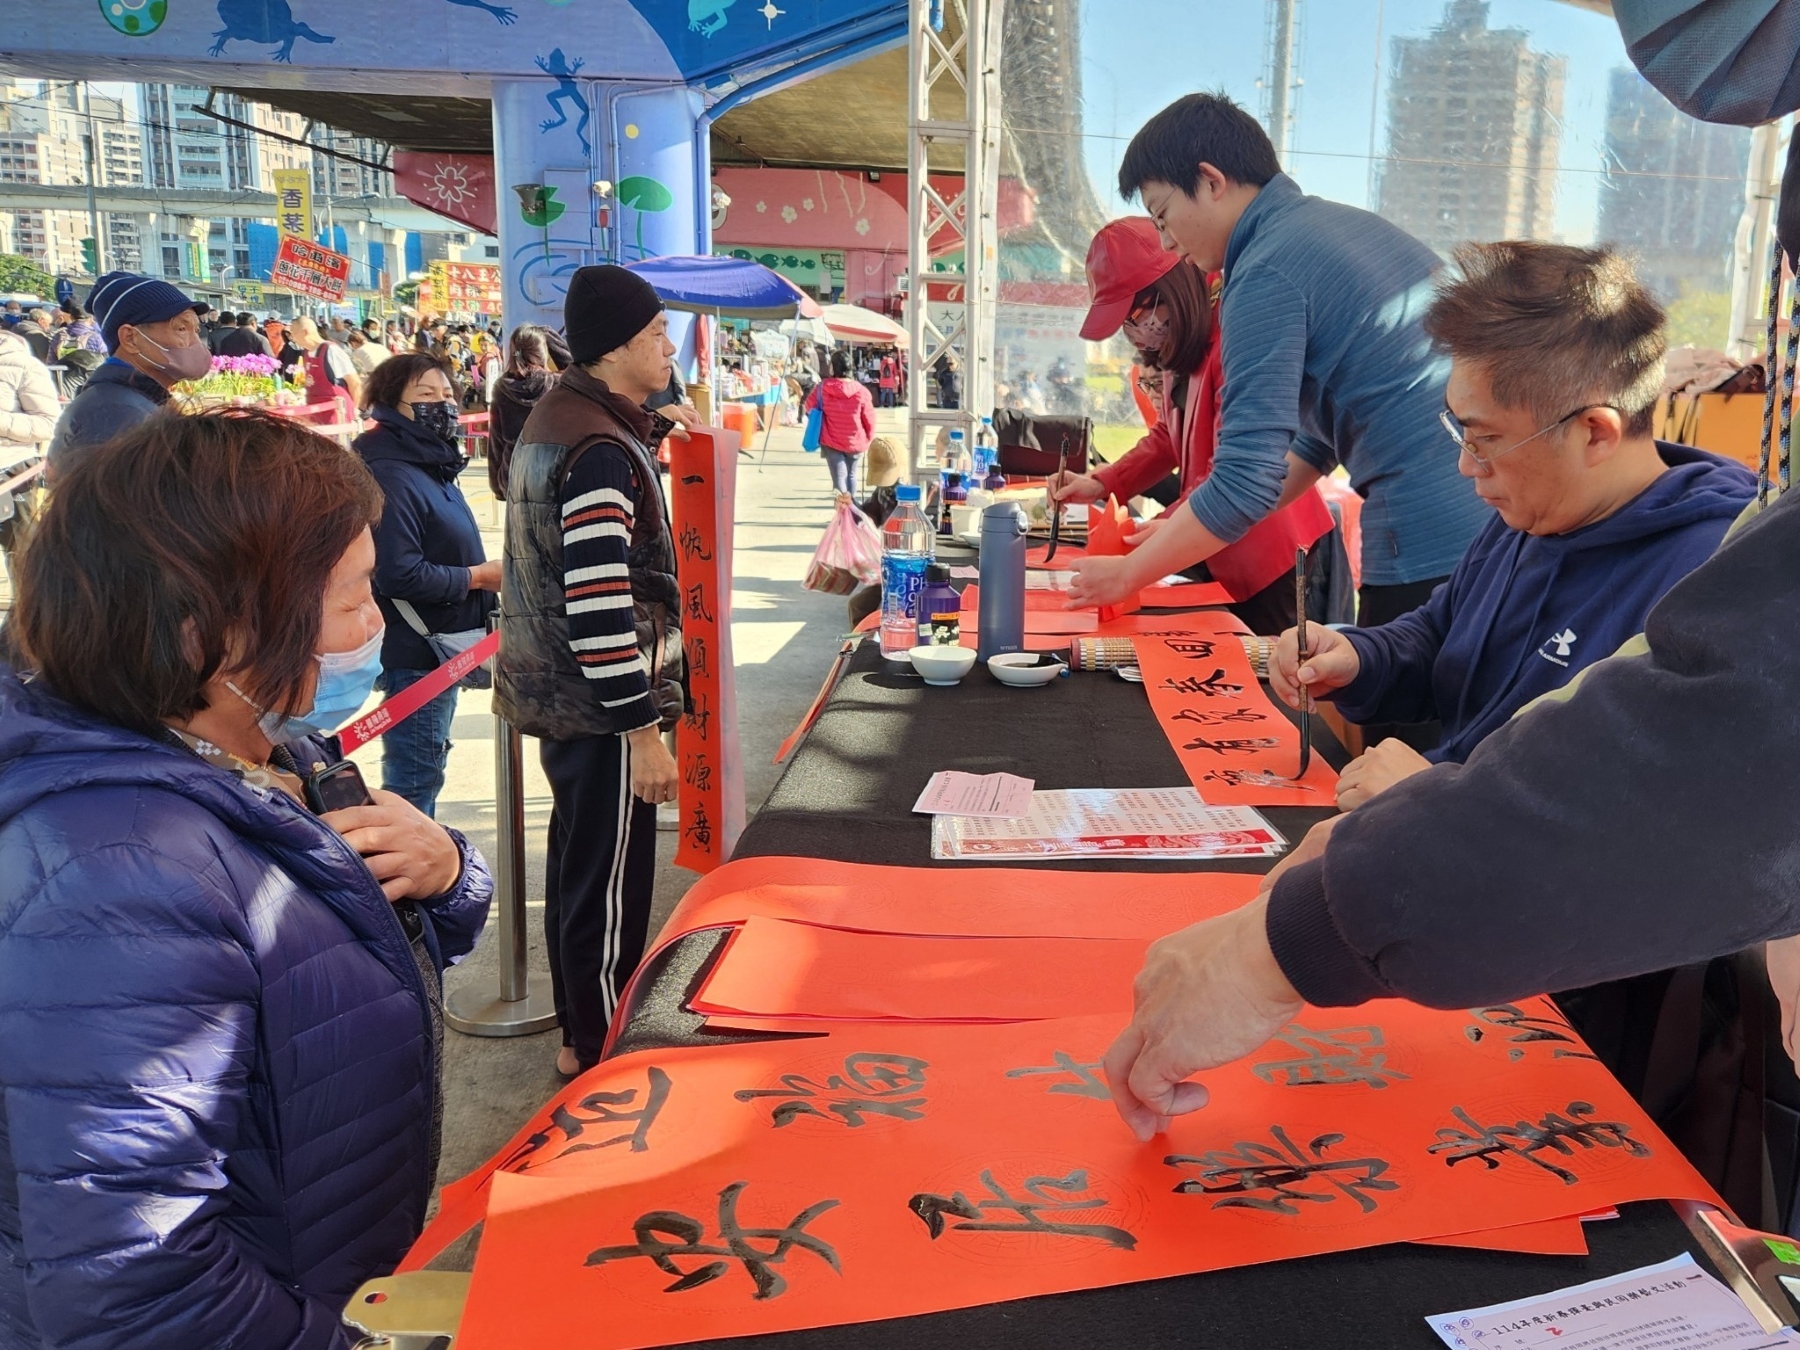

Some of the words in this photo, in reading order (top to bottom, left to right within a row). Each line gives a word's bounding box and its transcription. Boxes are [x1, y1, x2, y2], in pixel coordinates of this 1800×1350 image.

[679, 473, 713, 854] 一帆風順財源廣
[582, 1101, 1653, 1301] 安居樂業
